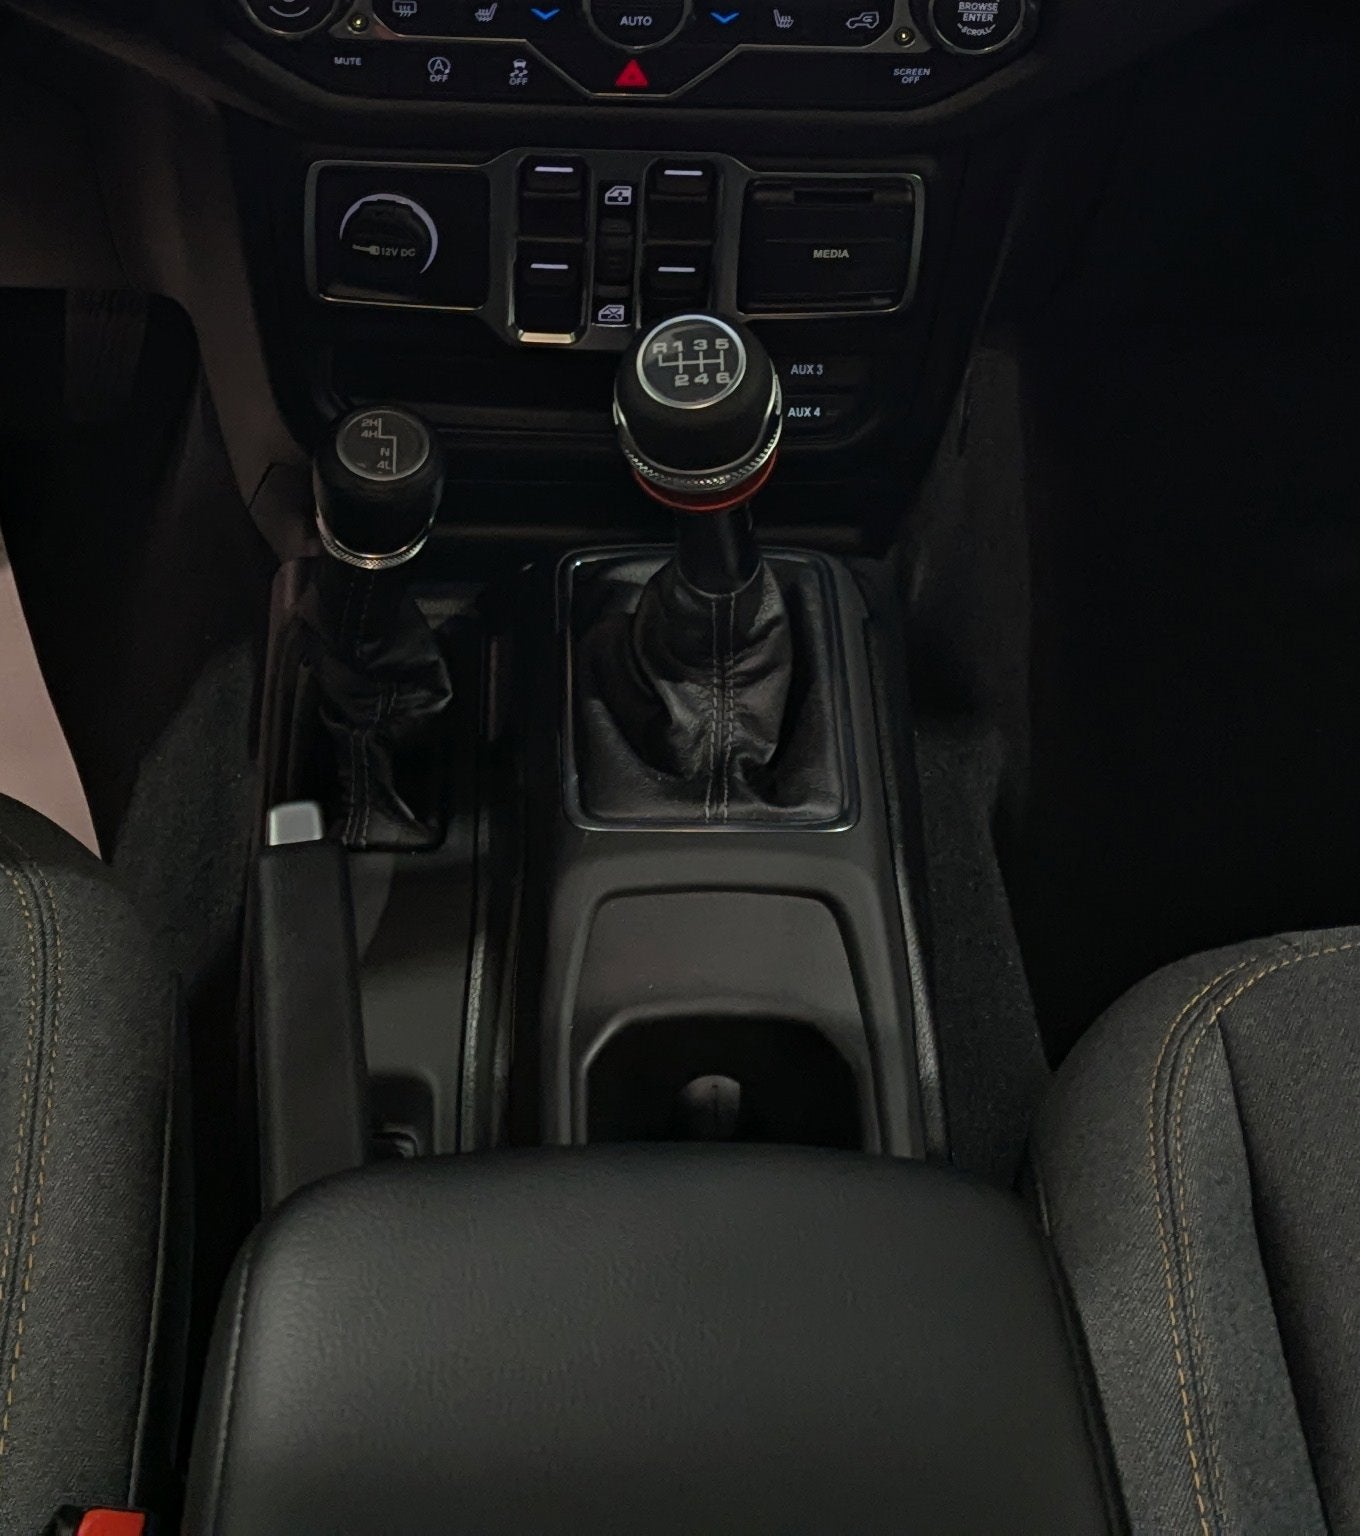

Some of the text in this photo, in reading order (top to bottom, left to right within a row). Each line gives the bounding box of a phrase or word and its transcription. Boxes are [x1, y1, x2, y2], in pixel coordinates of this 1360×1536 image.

[958, 1, 999, 11] BROWSE
[619, 15, 652, 27] AUTO
[962, 13, 994, 23] ENTER
[960, 24, 994, 36] SCROLL
[334, 56, 362, 66] MUTE
[893, 67, 931, 77] SCREEN
[429, 74, 449, 84] OFF
[509, 77, 529, 87] OFF
[901, 75, 920, 84] OFF
[380, 246, 416, 257] 12V DC
[813, 248, 849, 260] MEDIA
[652, 338, 729, 354] R 1 3 5
[790, 363, 823, 375] AUX 3
[674, 372, 731, 387] 2 4 6
[787, 406, 821, 418] AUX 4
[361, 419, 378, 427] 2H
[360, 430, 378, 438] 4H
[380, 447, 390, 457] N
